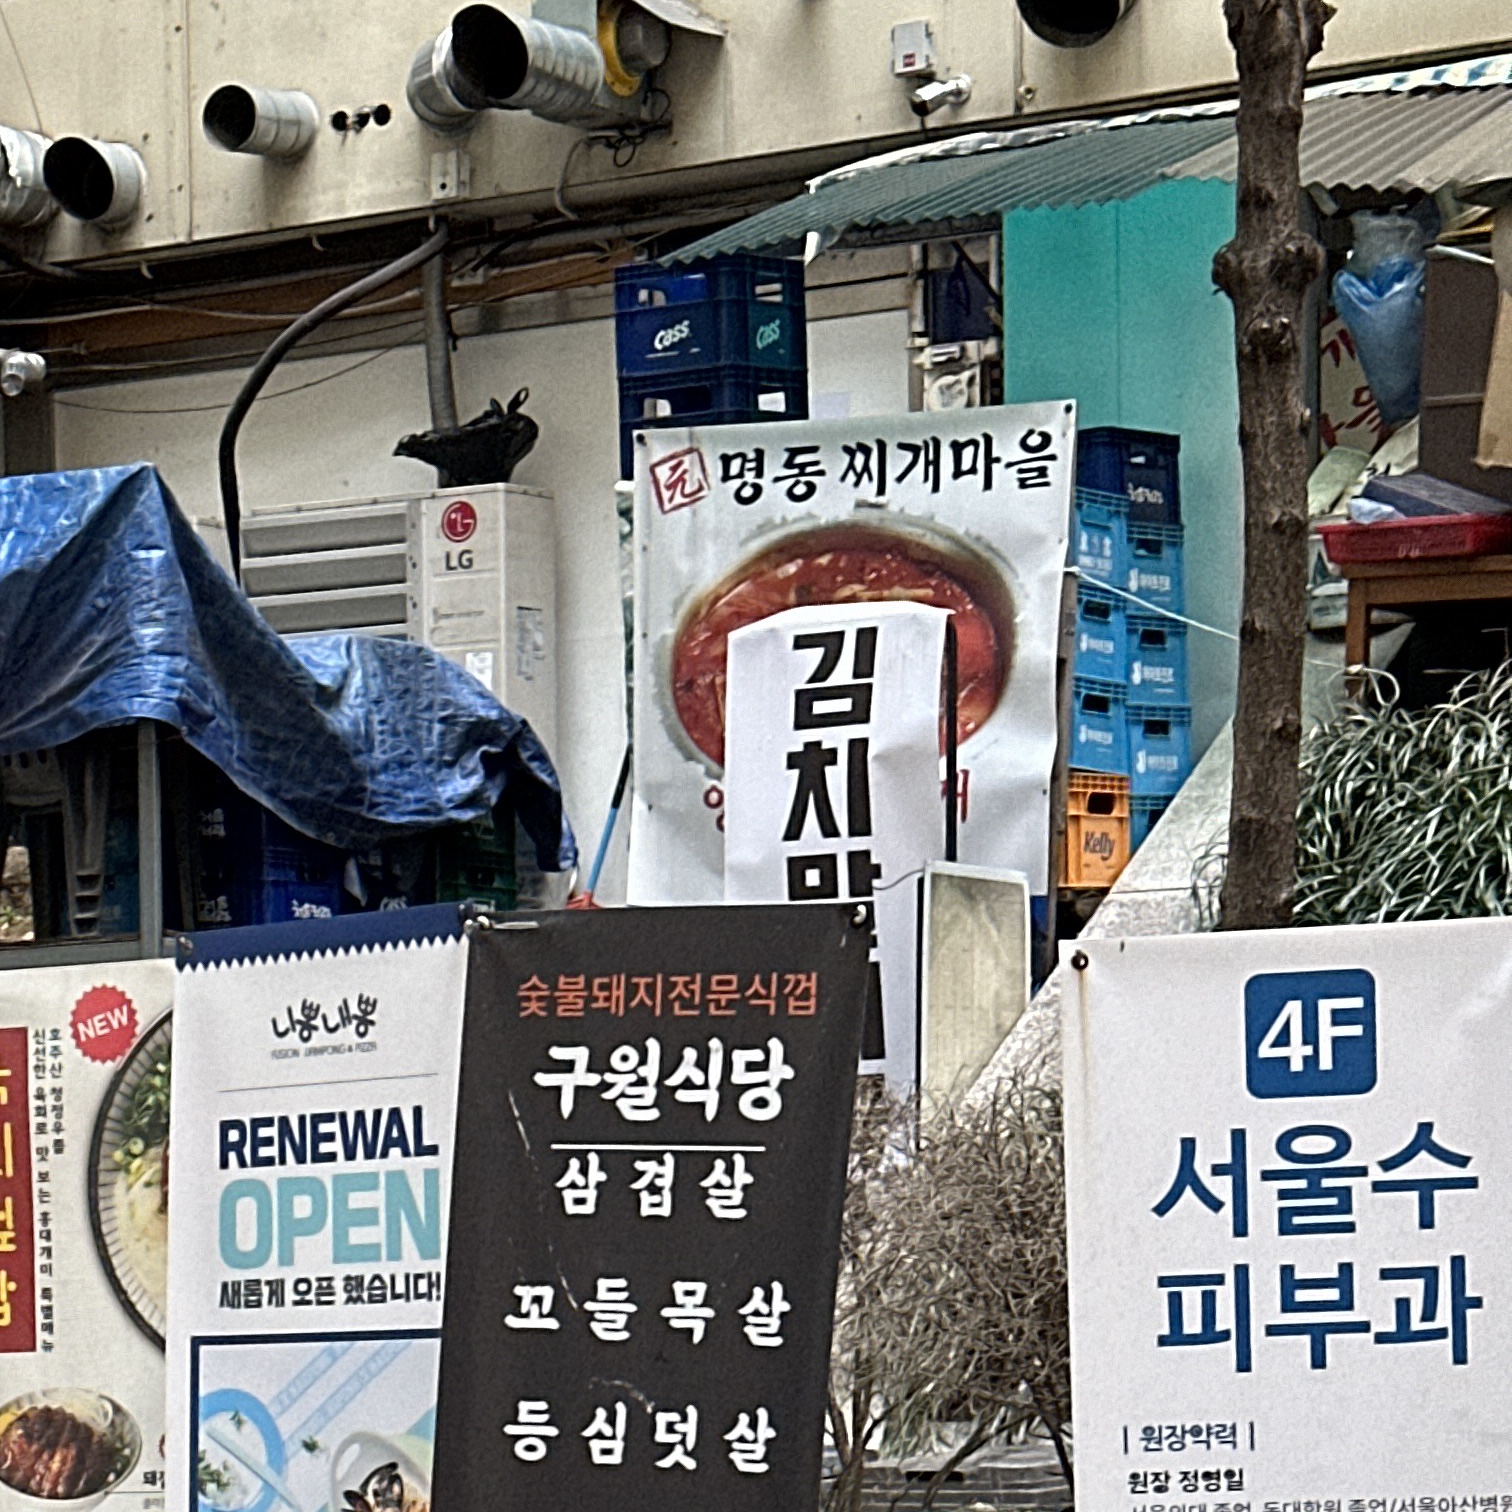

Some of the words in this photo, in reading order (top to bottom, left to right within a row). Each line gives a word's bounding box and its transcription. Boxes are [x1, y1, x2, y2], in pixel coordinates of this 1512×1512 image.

[653, 320, 690, 350] Cass
[445, 549, 473, 571] LG
[1084, 831, 1116, 861] Kelly
[76, 1004, 130, 1042] NEW
[1258, 997, 1365, 1073] 4F
[533, 1037, 795, 1122] 구월식당
[219, 1105, 439, 1170] RENEWAL
[1151, 1121, 1480, 1238] 서울수
[219, 1168, 441, 1271] OPEN
[219, 1278, 285, 1309] 새롭게
[292, 1276, 335, 1306] 오픈
[343, 1271, 441, 1305] 했습니다!
[1156, 1254, 1485, 1374] 피부과
[1140, 1423, 1237, 1452] 원장약력
[1128, 1470, 1170, 1494] 원장
